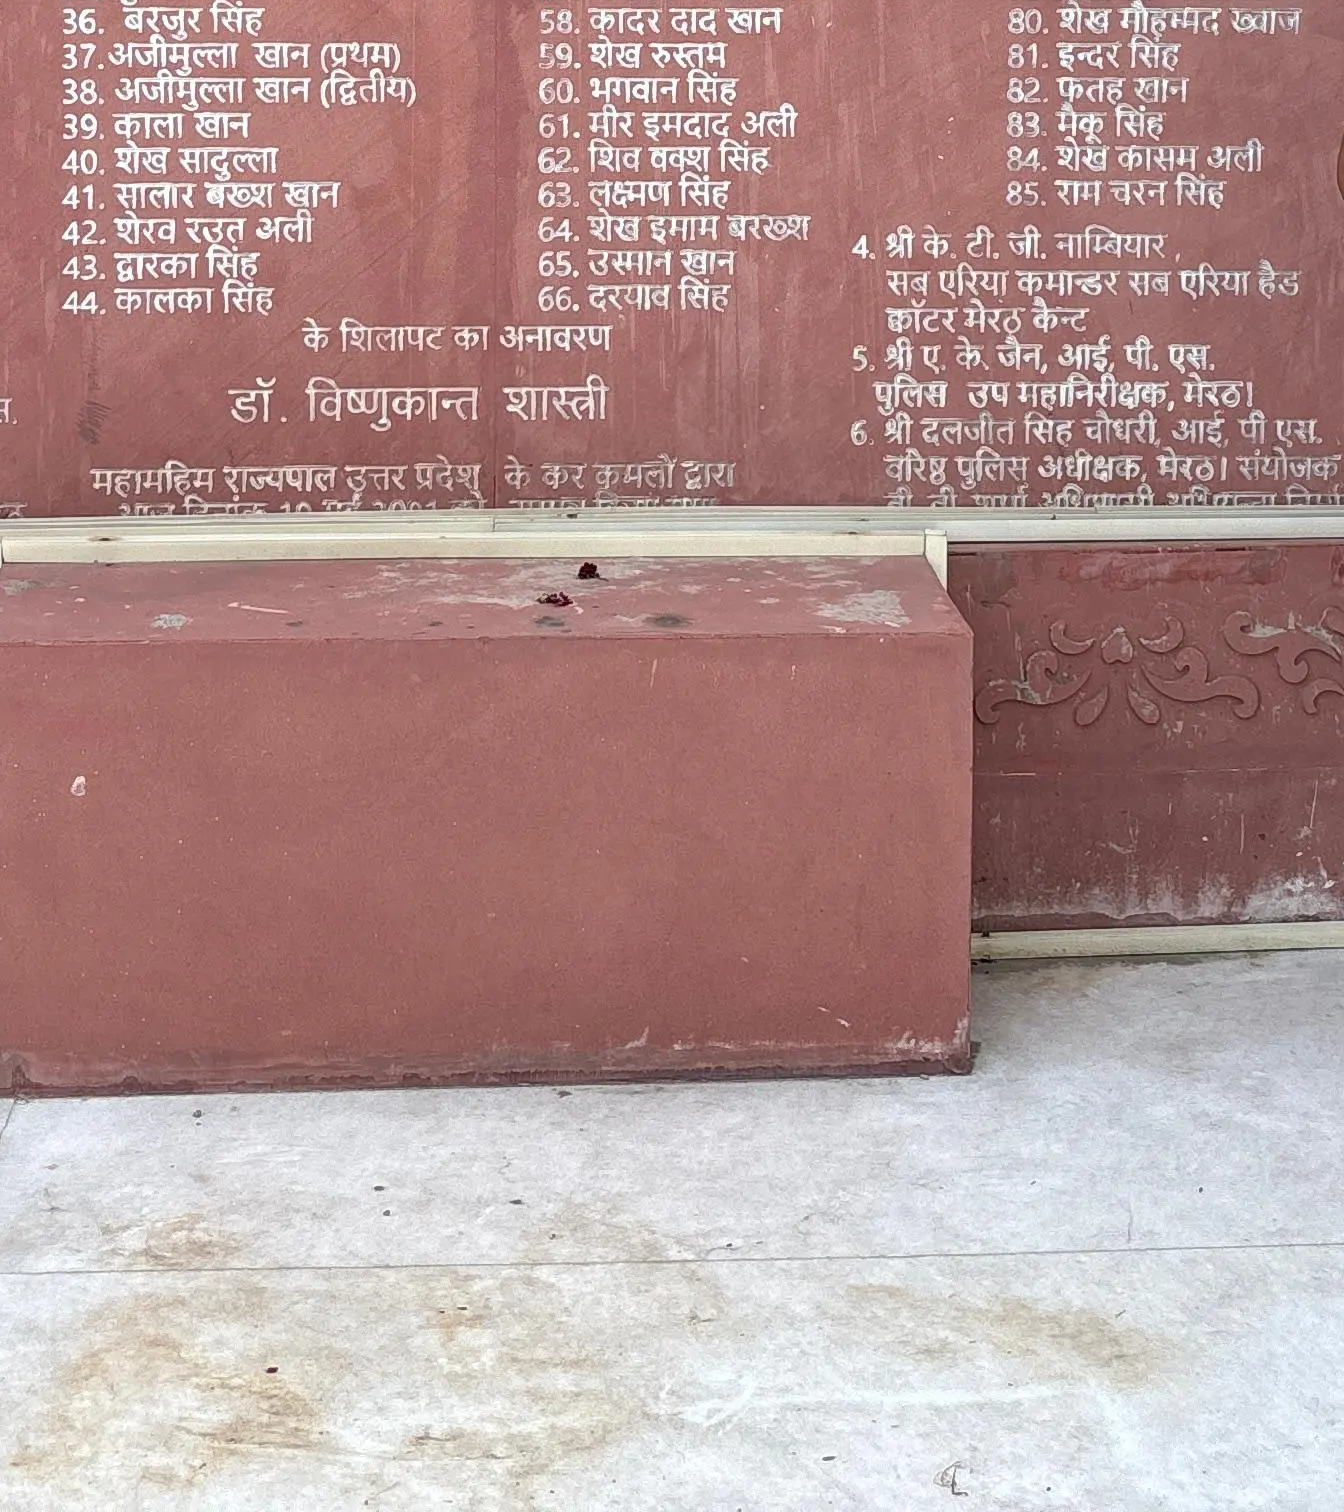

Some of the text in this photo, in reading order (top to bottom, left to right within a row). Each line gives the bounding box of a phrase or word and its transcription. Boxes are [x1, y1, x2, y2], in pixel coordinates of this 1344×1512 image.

[539, 69, 739, 106] 60. भगवान सिंह
[1006, 172, 1227, 209] 85. राम चरन सिंह
[852, 235, 875, 259] 4.
[886, 225, 915, 258] श्री
[922, 225, 956, 258] के.
[965, 225, 999, 259] टी.
[1007, 224, 1046, 259] जी.
[62, 279, 275, 316] 44. कालका सिंह
[302, 317, 331, 352] के
[452, 326, 490, 350] का
[500, 325, 613, 351] अनावरण
[872, 373, 948, 416] पुलिस
[966, 381, 1010, 408] उप
[90, 460, 216, 497] महामहिम
[223, 466, 338, 493] राज्यपाल
[414, 455, 481, 491] प्रदेश
[504, 456, 530, 489] के
[541, 464, 587, 489] कर
